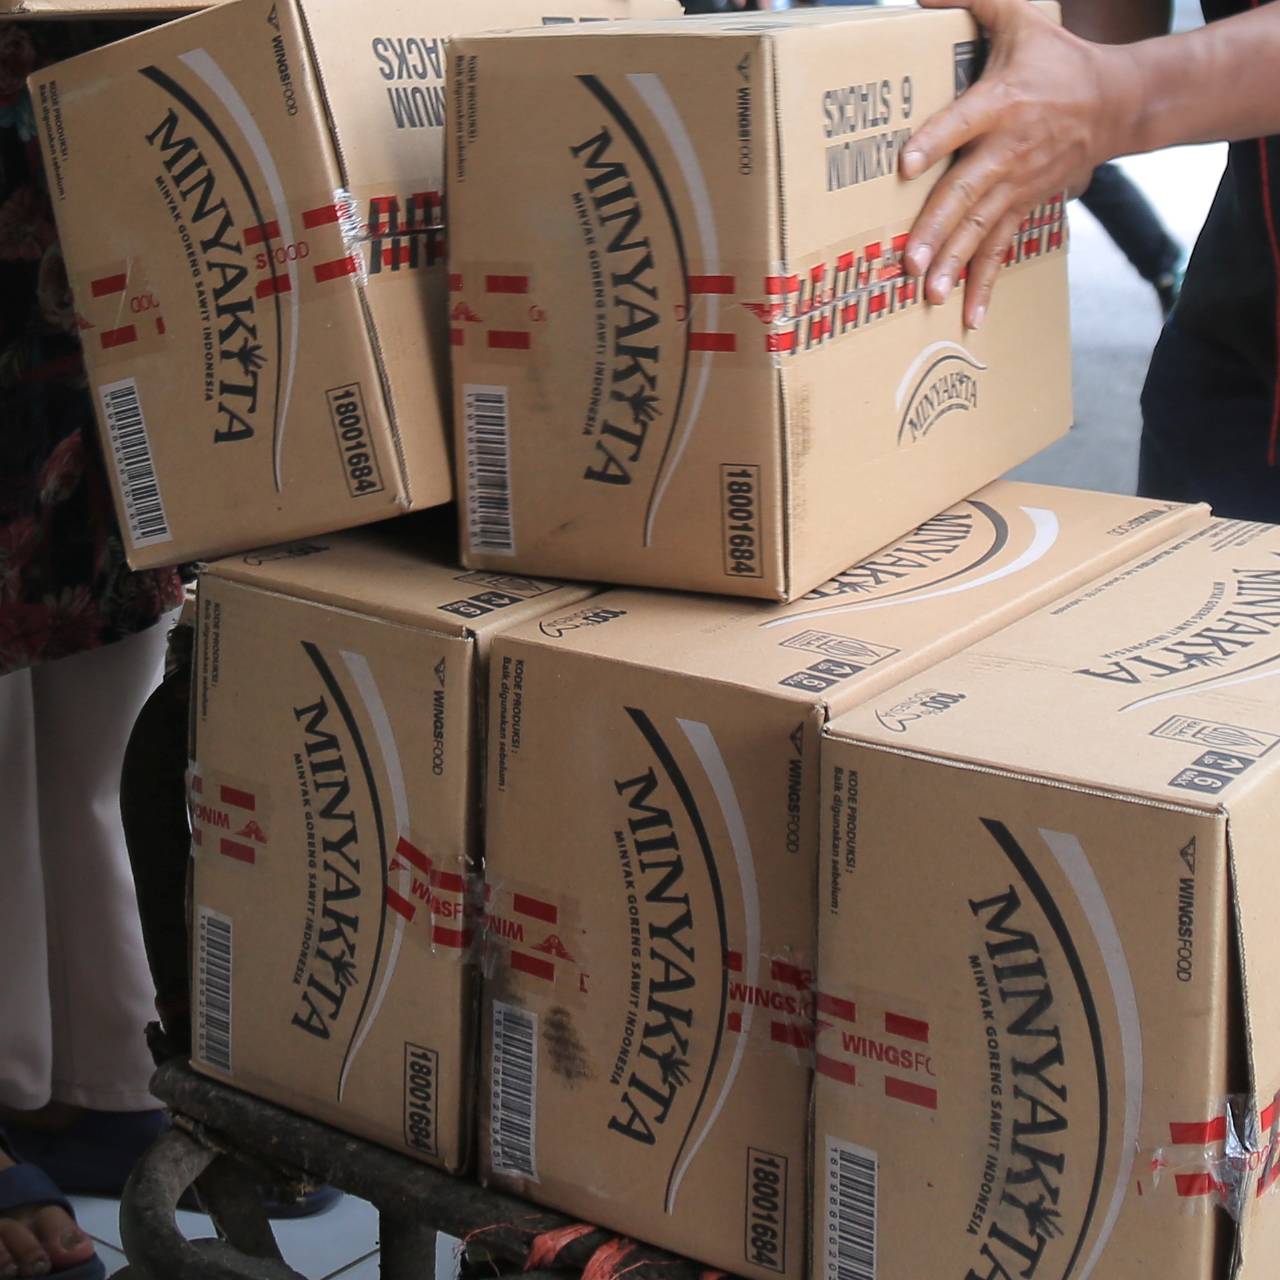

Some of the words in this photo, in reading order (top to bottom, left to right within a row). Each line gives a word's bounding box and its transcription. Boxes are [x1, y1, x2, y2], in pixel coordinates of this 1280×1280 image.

[271, 35, 298, 116] WINGSFOOD
[372, 37, 448, 81] ACKS
[901, 76, 914, 119] 6
[736, 86, 752, 177] WINGSFOOD
[155, 175, 181, 222] MINYAK
[572, 192, 595, 245] MINYAK
[145, 107, 268, 444] MINYAKITA
[178, 224, 200, 278] GORENG
[589, 250, 605, 308] GORENG
[195, 281, 210, 322] SAWIT
[569, 125, 665, 488] MINYAKITA
[202, 326, 215, 402] INDONESIA
[582, 361, 605, 435] INDONESIA
[332, 388, 375, 494] 18001684
[727, 467, 756, 577] 18001684
[803, 512, 973, 600] MINYAKIT
[803, 678, 827, 688] 6
[432, 690, 444, 776] WINGSFOOD
[293, 753, 312, 807] MINYAK
[785, 759, 803, 854] WINGSFOOD
[834, 766, 843, 792] Baik
[848, 770, 858, 804] KODE
[1174, 771, 1199, 786] MAX
[1193, 777, 1223, 788] 6
[305, 812, 317, 868] GORENG
[831, 794, 842, 857] digunakan
[846, 805, 857, 868] PRODUKSI
[292, 695, 361, 1040] MINYAKITA
[614, 831, 635, 889] MINYAK
[307, 873, 317, 915] SAWIT
[628, 895, 641, 957] GORENG
[293, 917, 315, 984] INDONESIA
[607, 766, 694, 1147] MINYAKITA
[1177, 877, 1194, 982] WINGSFOOD
[629, 961, 641, 1009] SAWIT
[968, 954, 994, 1021] MINYAK
[610, 1012, 636, 1085] INDONESIA
[986, 1026, 1003, 1097] GORENG
[407, 1049, 436, 1152] 18001684
[989, 1101, 1003, 1153] SAWIT
[749, 1151, 782, 1266] 18001684
[966, 1154, 1000, 1237] INDONESIA
